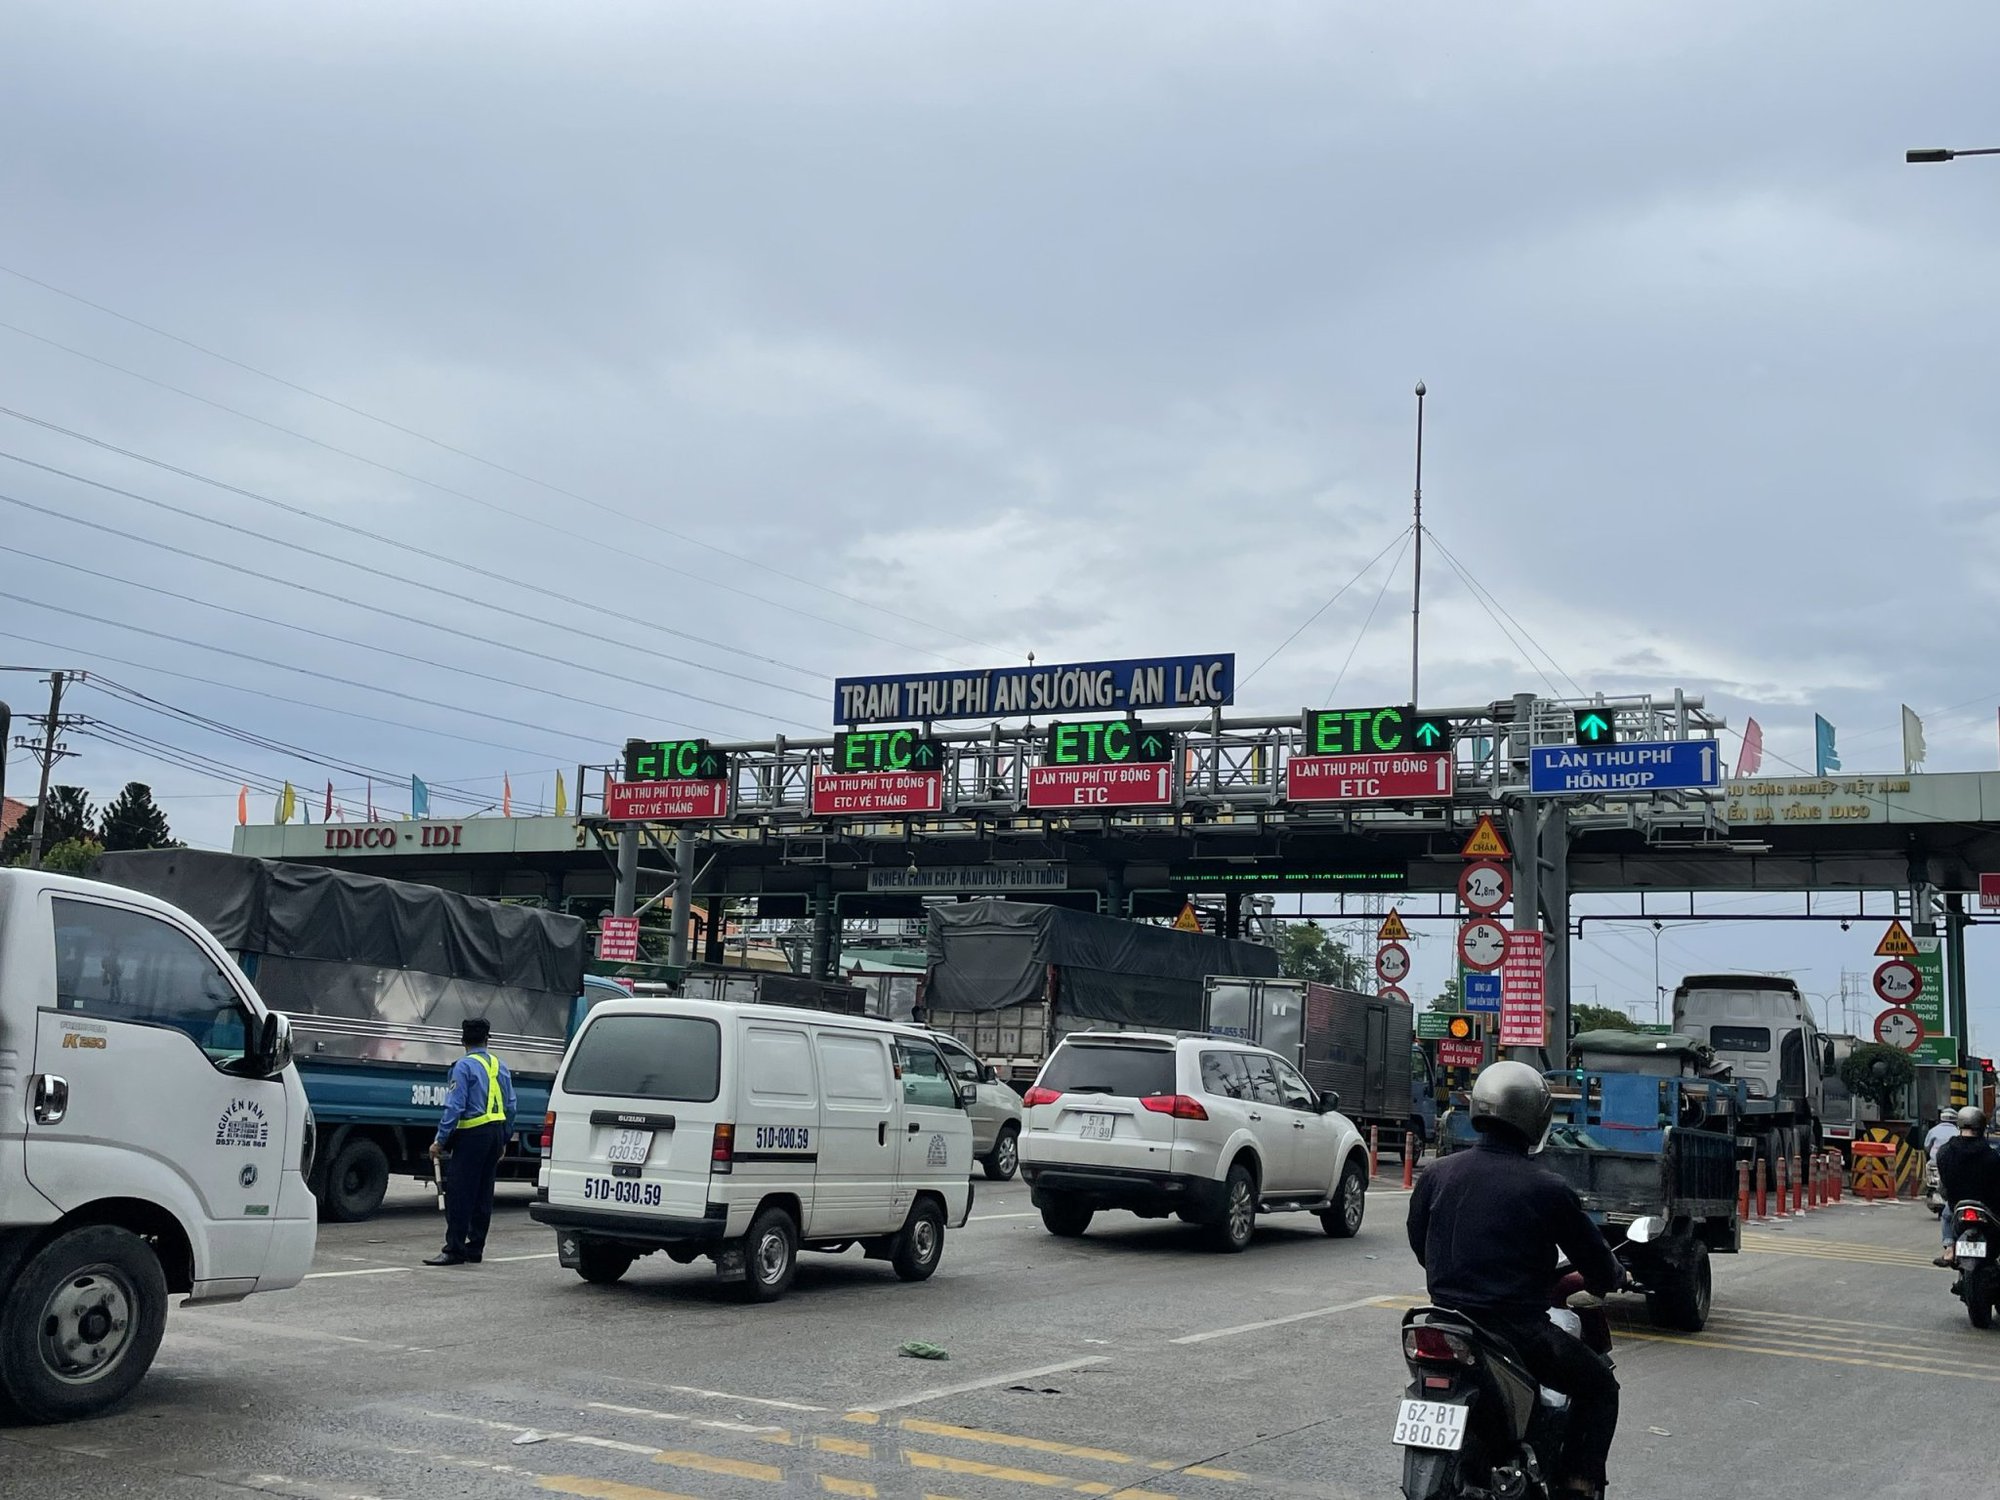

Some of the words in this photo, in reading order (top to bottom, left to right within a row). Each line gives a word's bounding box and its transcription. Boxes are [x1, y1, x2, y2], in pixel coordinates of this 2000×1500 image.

[840, 682, 900, 723] TRẠM
[905, 679, 949, 716] THU
[952, 671, 991, 714] PHÍ
[994, 674, 1027, 712] AN
[1129, 666, 1165, 705] AN
[1175, 661, 1223, 706] LẠC
[1316, 708, 1402, 753] ETC
[846, 730, 913, 769] ETC
[1056, 721, 1131, 763] ETC
[1296, 761, 1319, 777] LÀN
[1323, 762, 1347, 776] THU
[1350, 758, 1371, 775] PHÍ
[1372, 760, 1390, 776] TỰ
[1392, 758, 1428, 776] ĐỘNG
[1545, 750, 1588, 769] LÀN
[1592, 750, 1635, 766] THU
[1638, 746, 1675, 764] PHÍ
[818, 779, 837, 792] LÀN
[840, 779, 859, 791] THU
[861, 776, 877, 790] PHÍ
[880, 778, 893, 792] TỰ
[897, 776, 924, 791] ĐỘNG
[1035, 769, 1056, 785] LÀN
[1058, 771, 1080, 784] THU
[1082, 768, 1100, 784] PHÍ
[1103, 769, 1118, 785] TỰ
[1120, 767, 1151, 784] ĐỘNG
[1565, 769, 1608, 789] HỖN
[1611, 771, 1655, 789] HỢP
[615, 786, 632, 800] LÀN
[634, 785, 652, 799] THU
[653, 783, 669, 798] PHÍ
[671, 785, 683, 801] TỰ
[685, 783, 710, 799] ĐỘNG
[1074, 787, 1108, 804] ETC
[1340, 778, 1380, 797] ETC
[664, 800, 694, 815] THÁNG
[875, 793, 907, 807] THÁNG
[1828, 805, 1870, 819] IDICO
[325, 827, 397, 849] IDICO
[420, 825, 463, 847] IDI
[1474, 878, 1496, 898] 2,8m
[618, 1115, 646, 1123] SUZUKI
[620, 1130, 643, 1146] 51D
[756, 1126, 809, 1149] 51D-030.59
[584, 1177, 662, 1206] 51D-030.59
[1407, 1402, 1456, 1426] 62-B1
[1396, 1422, 1460, 1448] 380.67
